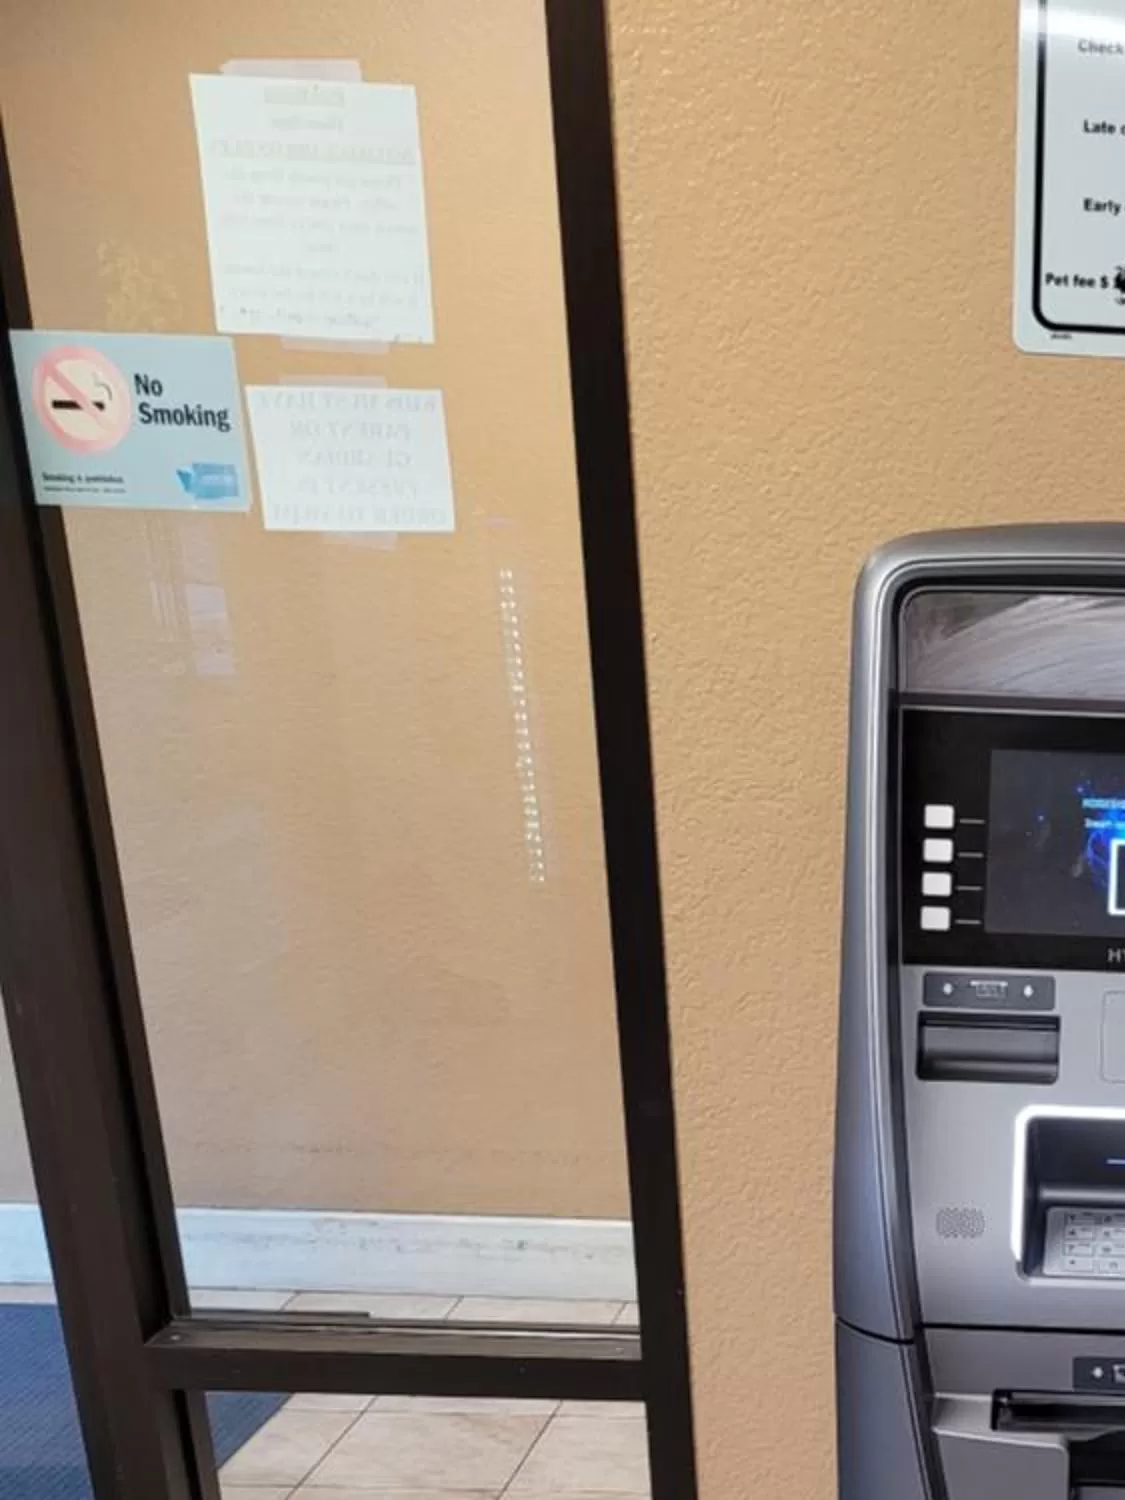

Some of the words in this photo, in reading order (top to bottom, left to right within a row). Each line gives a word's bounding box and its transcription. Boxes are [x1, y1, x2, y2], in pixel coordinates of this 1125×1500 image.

[1077, 38, 1124, 56] Check
[1083, 119, 1117, 135] Late
[1083, 197, 1122, 217] Early
[1045, 272, 1070, 288] Pet
[1072, 274, 1096, 289] fee
[1099, 275, 1110, 290] $
[133, 372, 164, 397] No
[137, 401, 231, 433] Smoking
